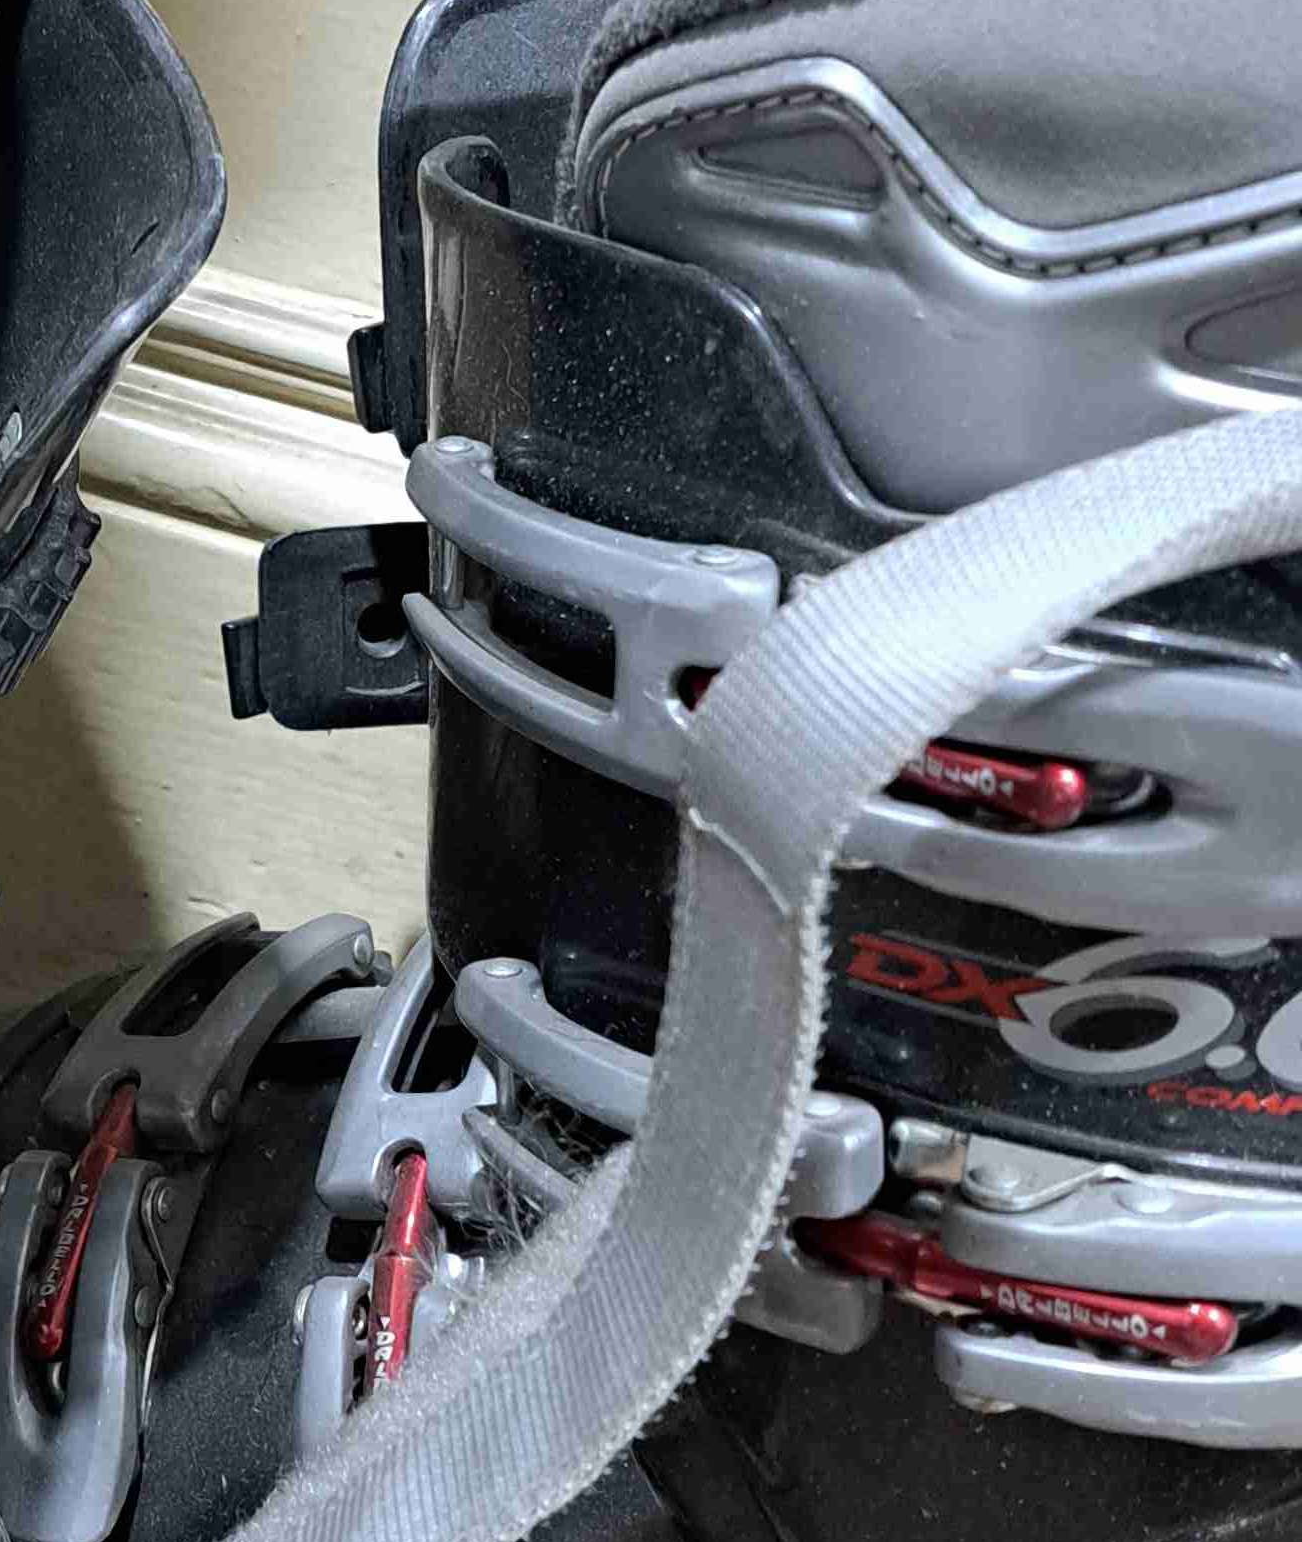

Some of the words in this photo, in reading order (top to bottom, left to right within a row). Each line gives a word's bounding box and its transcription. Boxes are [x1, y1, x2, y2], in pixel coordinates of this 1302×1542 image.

[847, 932, 1070, 1026] DX
[999, 935, 1302, 1093] 6.
[39, 1193, 89, 1297] DALBELLO
[998, 1285, 1148, 1339] DALBELLO
